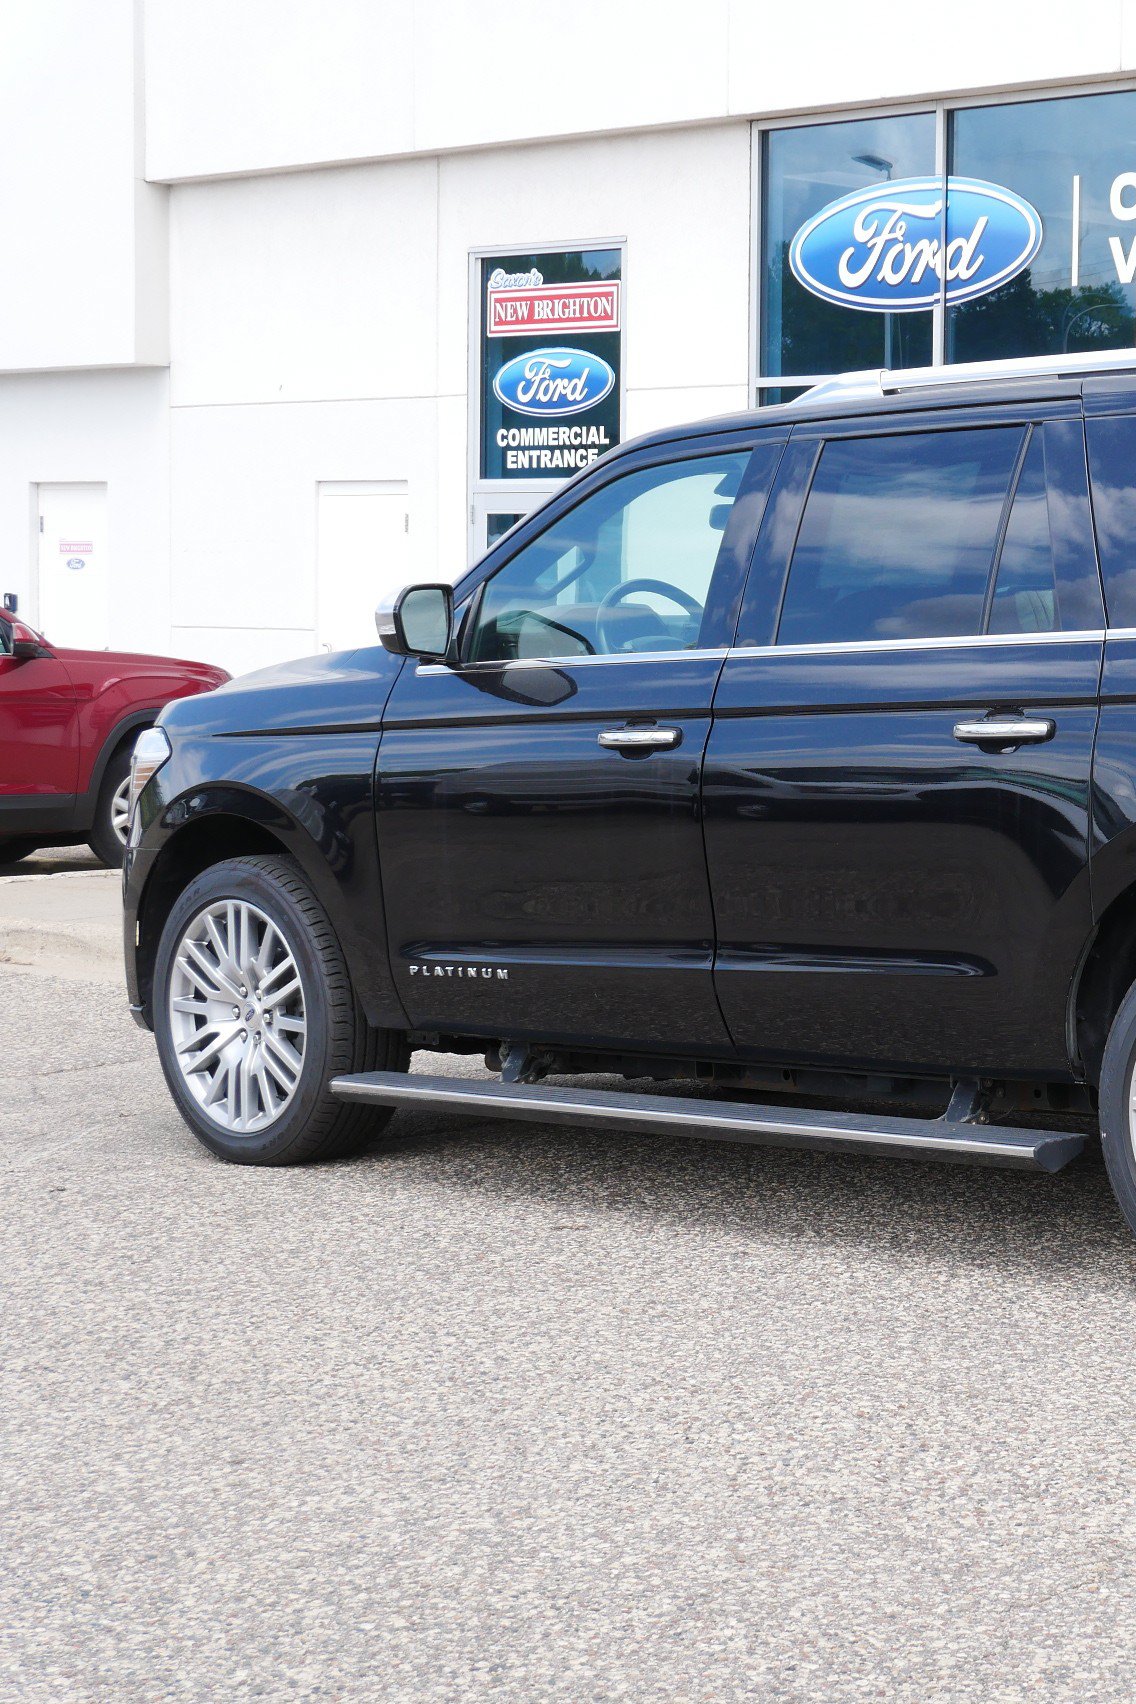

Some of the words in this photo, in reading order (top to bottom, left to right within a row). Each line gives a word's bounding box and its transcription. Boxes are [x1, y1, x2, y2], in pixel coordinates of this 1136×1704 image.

[838, 199, 989, 288] Ford
[489, 269, 541, 289] Saxon's
[494, 300, 530, 321] NEW
[533, 296, 613, 320] BRIGHTON
[516, 357, 591, 403] Ford
[496, 425, 610, 447] COMMERCIAL
[506, 448, 599, 469] ENTRANCE
[409, 965, 509, 980] PLATINUM
